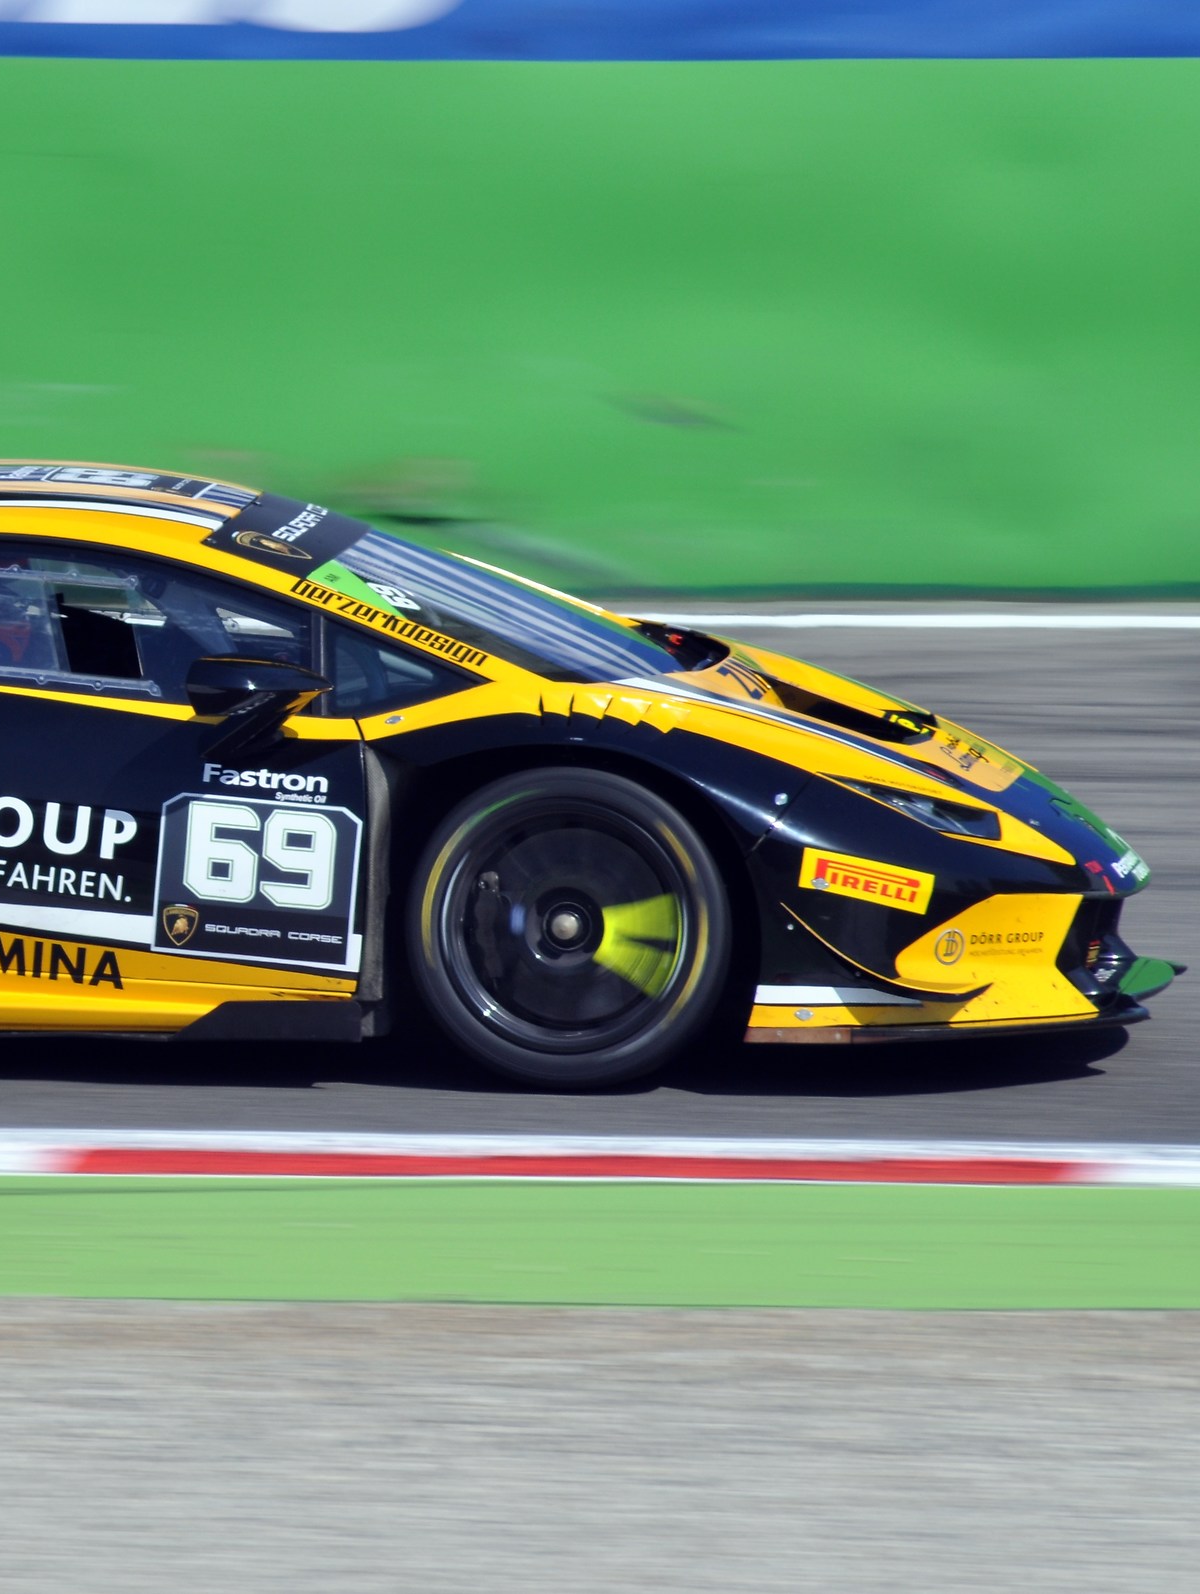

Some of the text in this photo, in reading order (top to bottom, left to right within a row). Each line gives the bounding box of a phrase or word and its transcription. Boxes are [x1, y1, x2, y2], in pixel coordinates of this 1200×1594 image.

[202, 763, 328, 792] Fastron
[275, 791, 327, 803] Synthetic Oil
[183, 801, 337, 910] 69
[815, 858, 920, 903] PIRELLI
[205, 924, 343, 944] SQUADRA CORSE
[1006, 932, 1044, 943] GROUP
